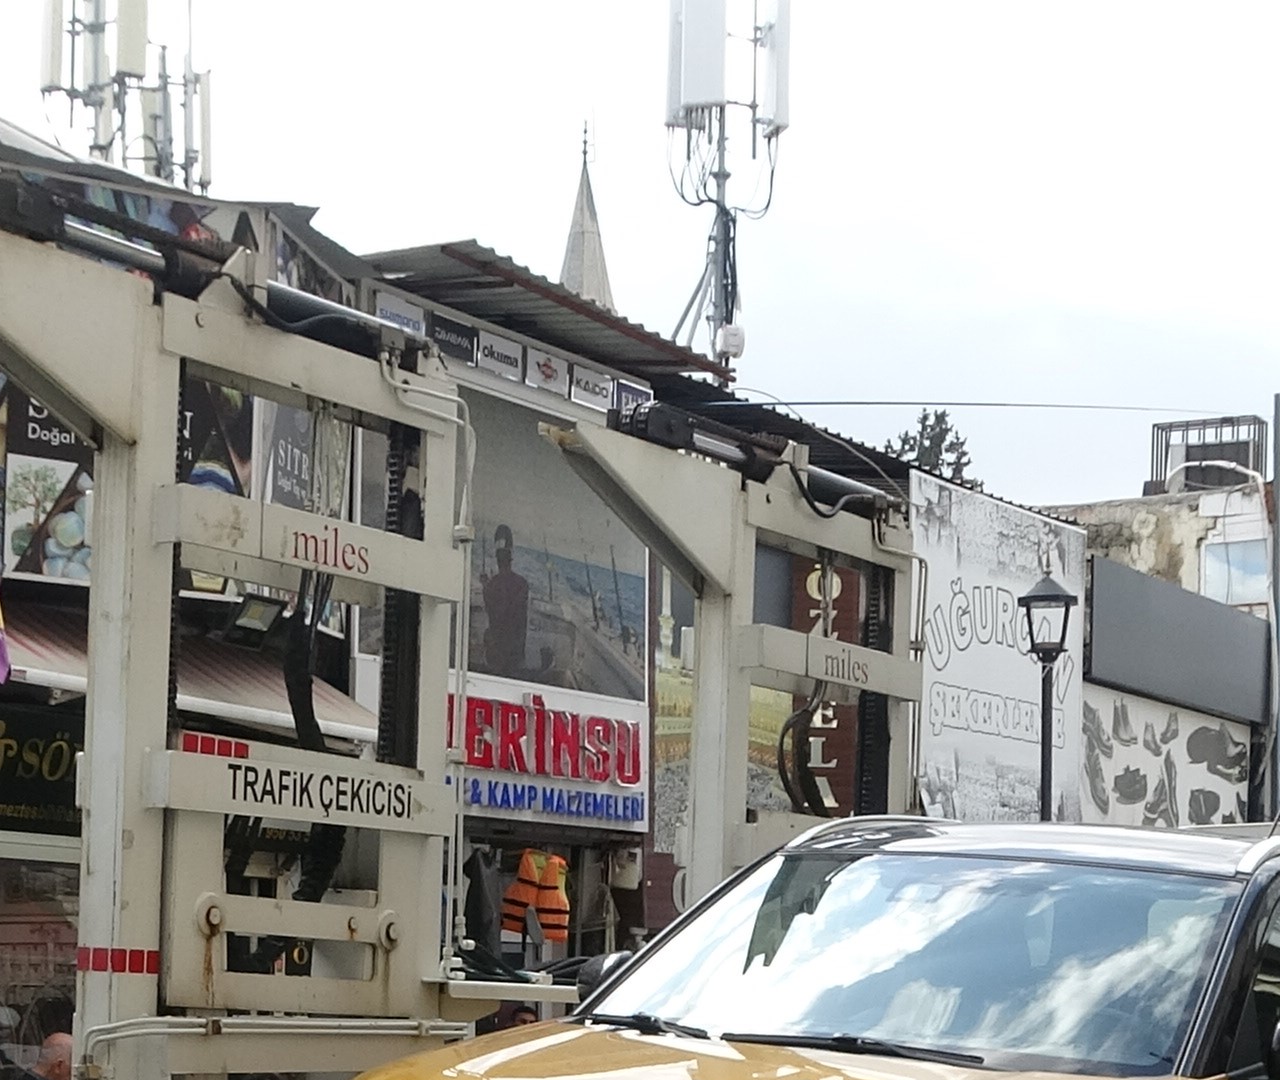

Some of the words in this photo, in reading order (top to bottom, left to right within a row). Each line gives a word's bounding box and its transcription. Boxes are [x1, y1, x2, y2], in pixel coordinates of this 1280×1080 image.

[482, 344, 519, 369] okuma
[27, 422, 75, 446] Doğal
[278, 438, 309, 481] SİTR
[292, 524, 370, 575] miles
[824, 648, 869, 684] miles
[930, 681, 1066, 750] ŞEKERLEE
[447, 693, 641, 787] ERİNSU
[488, 780, 538, 810] KAMP
[542, 787, 645, 822] MALZEMELERİ
